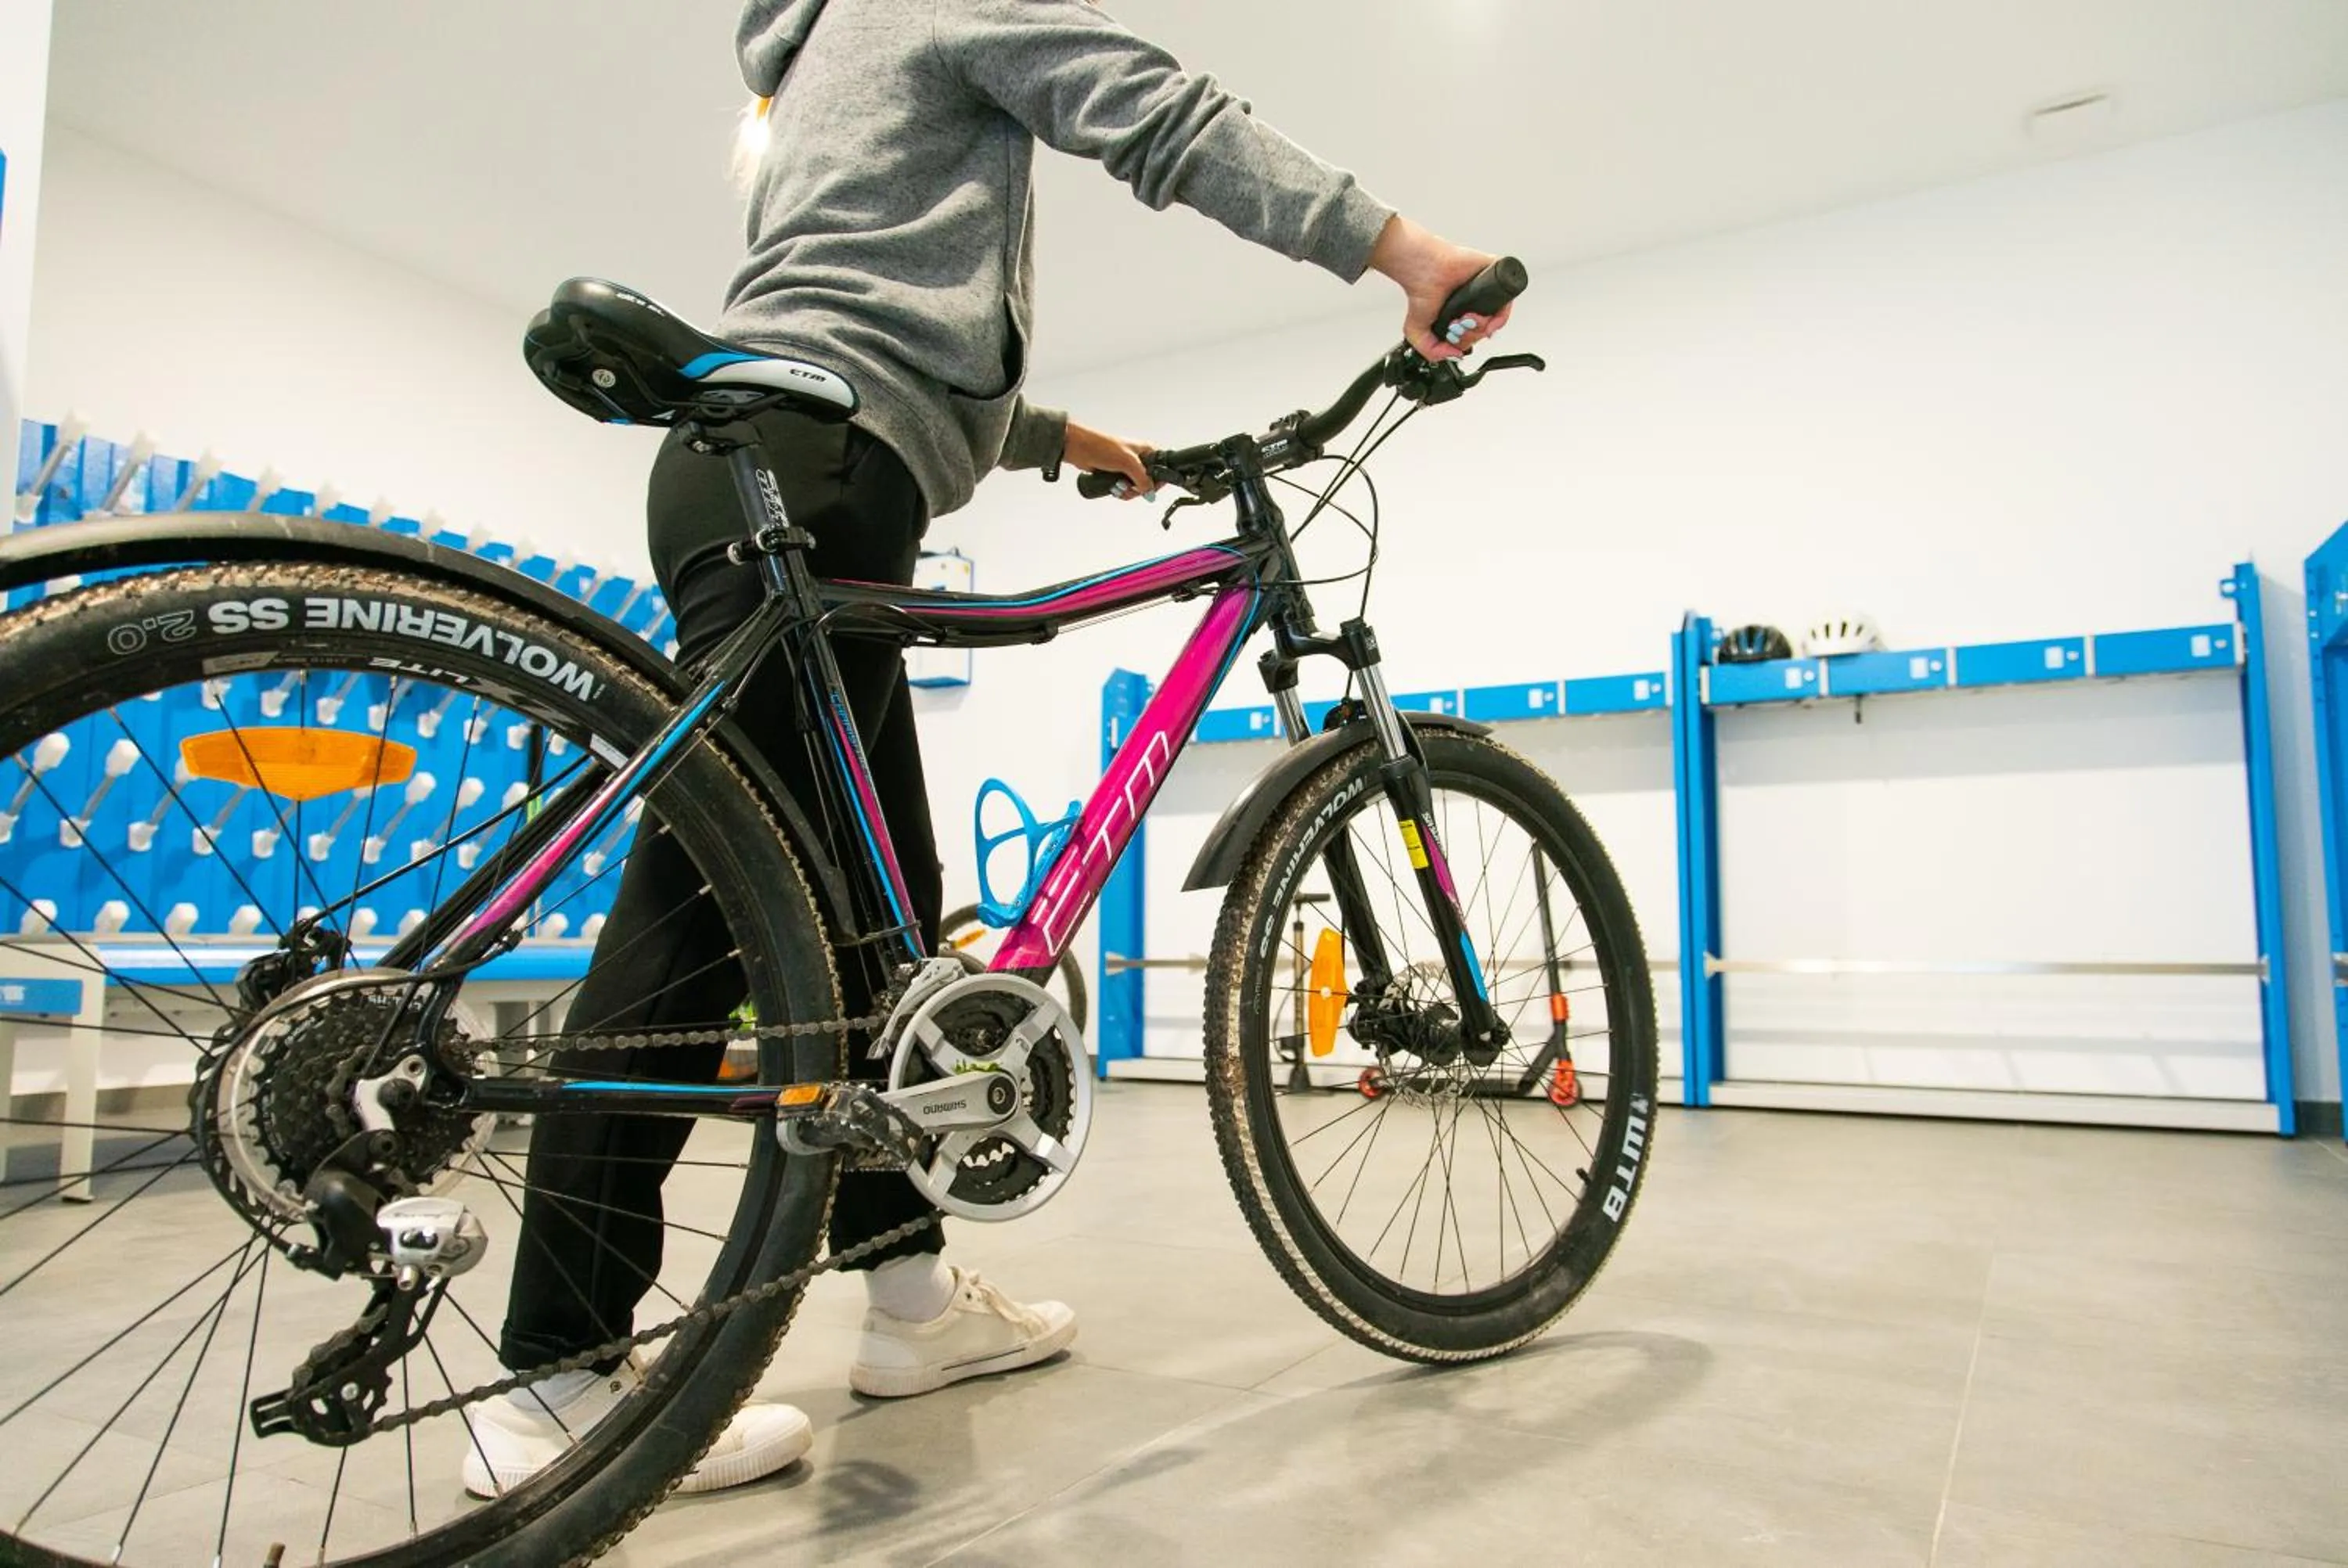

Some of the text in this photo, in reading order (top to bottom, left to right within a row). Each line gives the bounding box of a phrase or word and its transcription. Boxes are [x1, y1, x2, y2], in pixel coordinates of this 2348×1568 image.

[108, 609, 196, 655] 2.0
[208, 598, 289, 634] SS
[304, 597, 595, 701] WOLVERINE
[1259, 777, 1364, 959] WOLVERINE SS
[923, 1100, 967, 1115] SHIMANO
[1602, 1115, 1647, 1222] WTB
